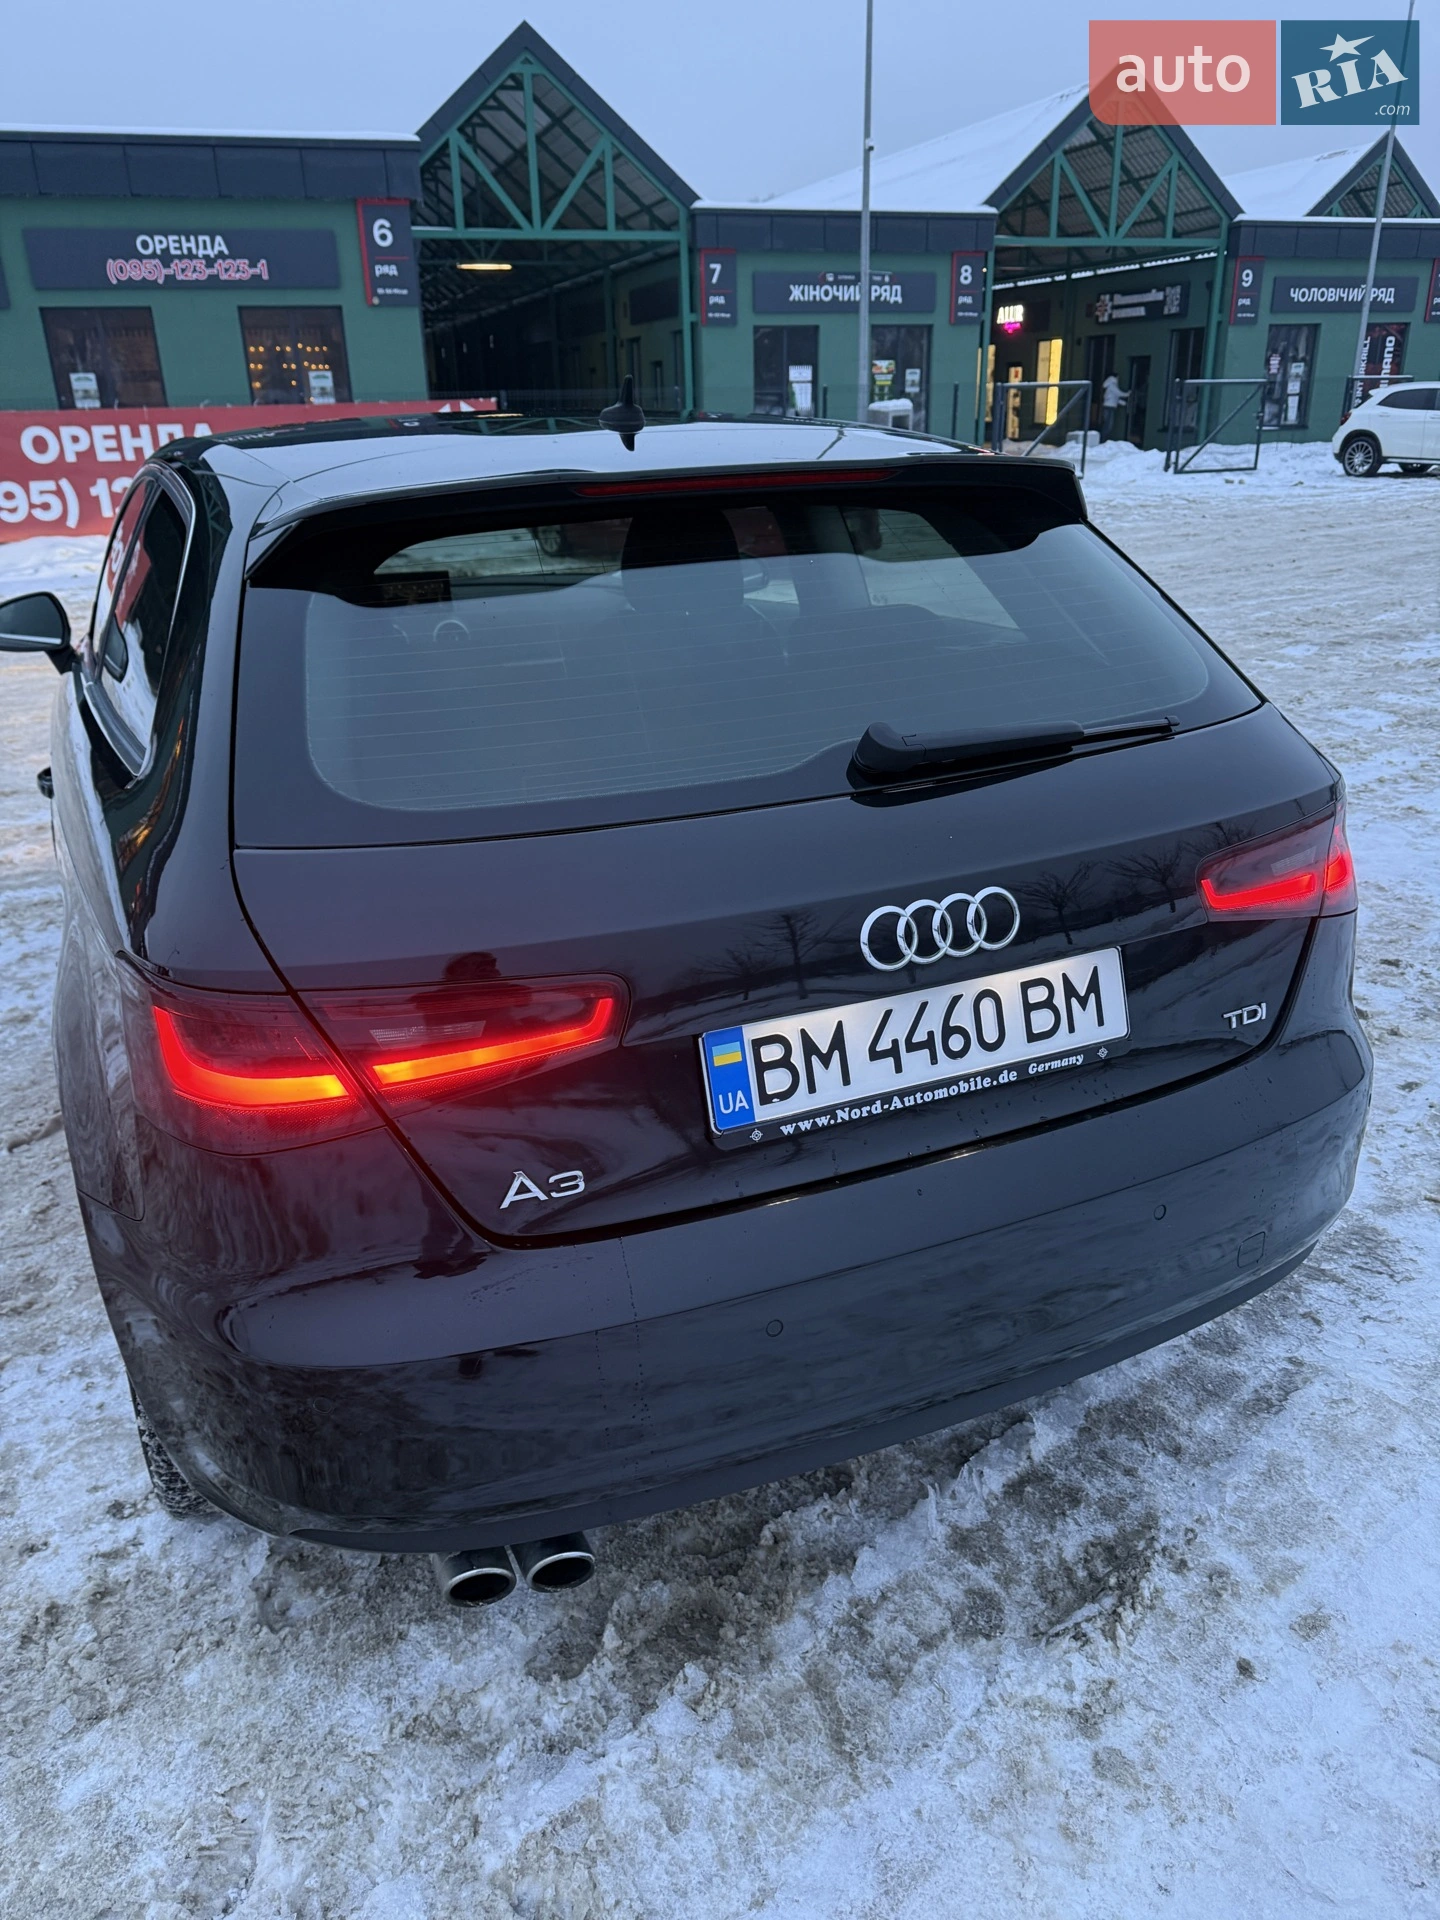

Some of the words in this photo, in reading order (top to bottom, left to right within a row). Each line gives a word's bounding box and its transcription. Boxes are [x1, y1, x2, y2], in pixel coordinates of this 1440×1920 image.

[372, 217, 394, 248] 6
[135, 234, 230, 258] ОРЕНДА
[106, 258, 270, 285] (095)-123-123-1
[709, 263, 722, 285] 7
[960, 264, 973, 286] 8
[1241, 268, 1254, 288] 9
[870, 284, 903, 304] РЯД
[1370, 287, 1396, 304] РЯД
[1222, 1002, 1267, 1029] TDI
[752, 1019, 852, 1107] BM
[867, 987, 1007, 1075] 4460
[1019, 965, 1105, 1044] BM
[718, 1090, 750, 1115] UA
[779, 1070, 1018, 1136] www.Nord-Automobile.de
[1028, 1053, 1084, 1075] Germany
[499, 1169, 586, 1210] A3
